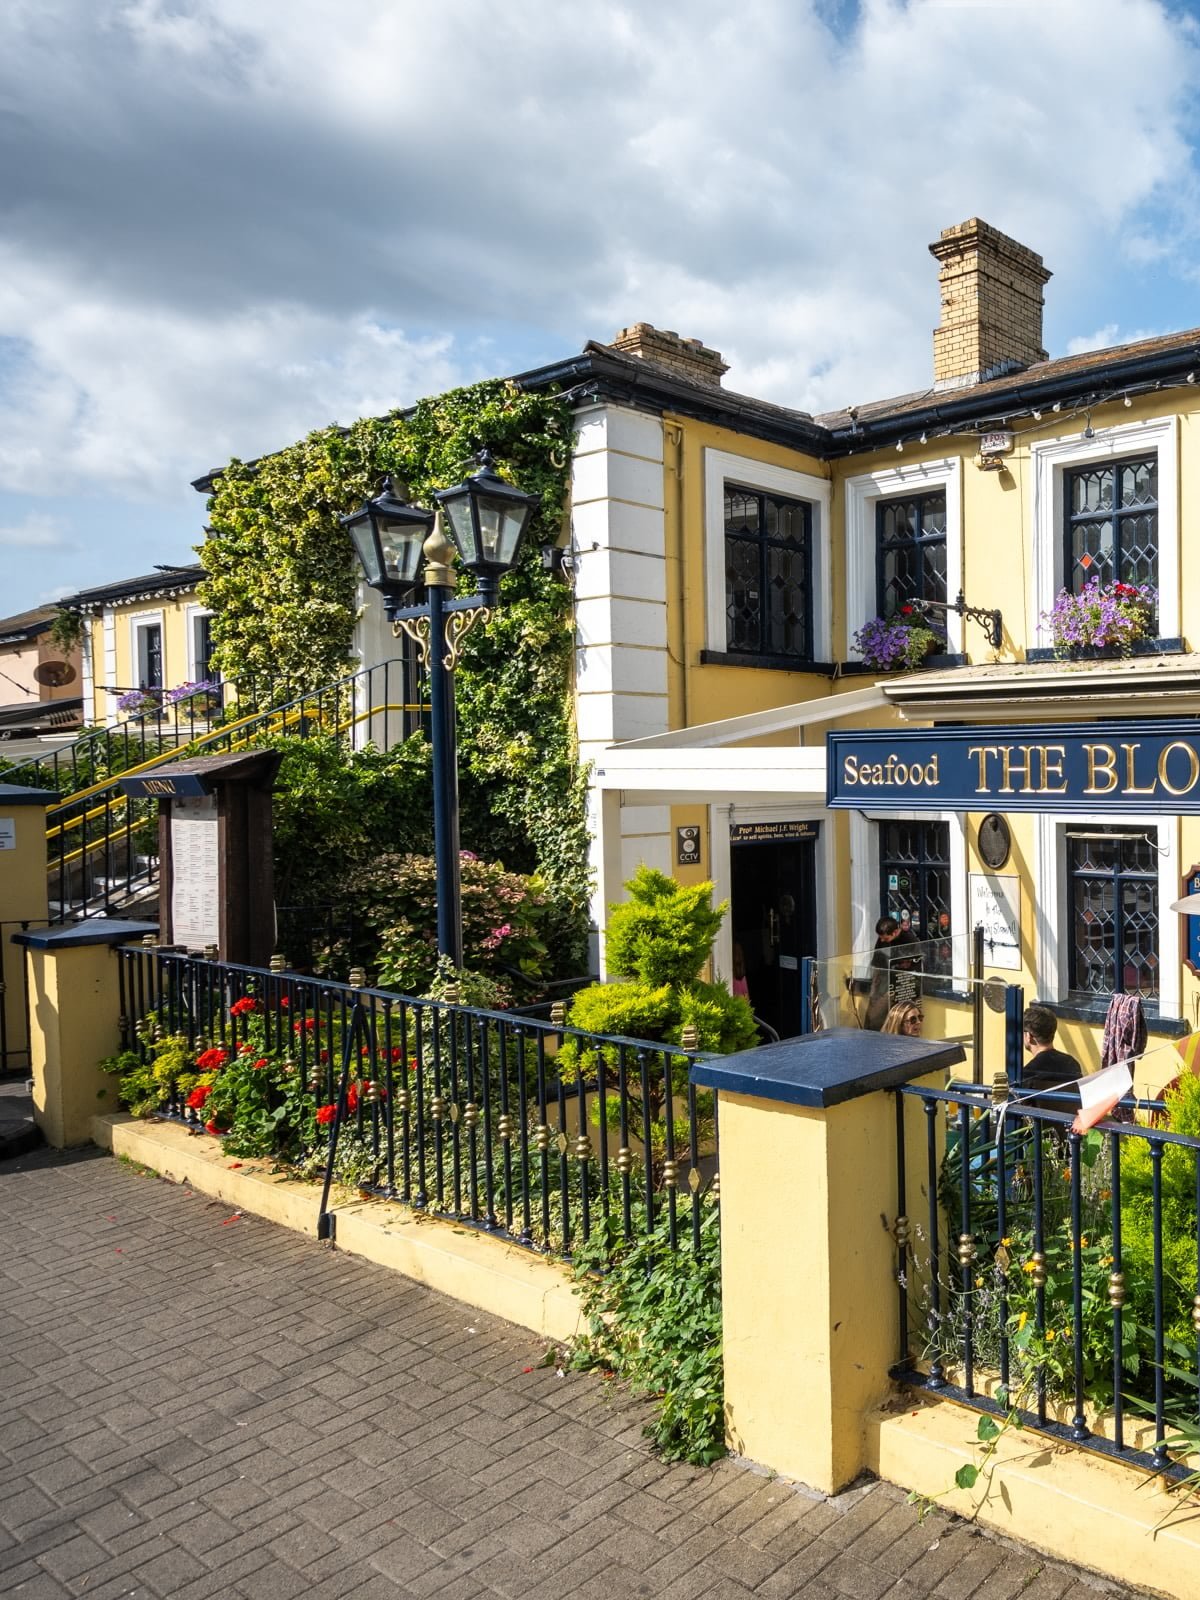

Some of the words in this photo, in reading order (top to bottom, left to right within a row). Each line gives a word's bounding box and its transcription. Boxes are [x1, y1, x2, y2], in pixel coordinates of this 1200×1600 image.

[843, 753, 940, 786] Seafood
[967, 743, 1069, 794] THE
[141, 779, 177, 795] MENU
[754, 824, 778, 833] Michael
[789, 823, 808, 832] Wright
[680, 853, 699, 861] CCTV
